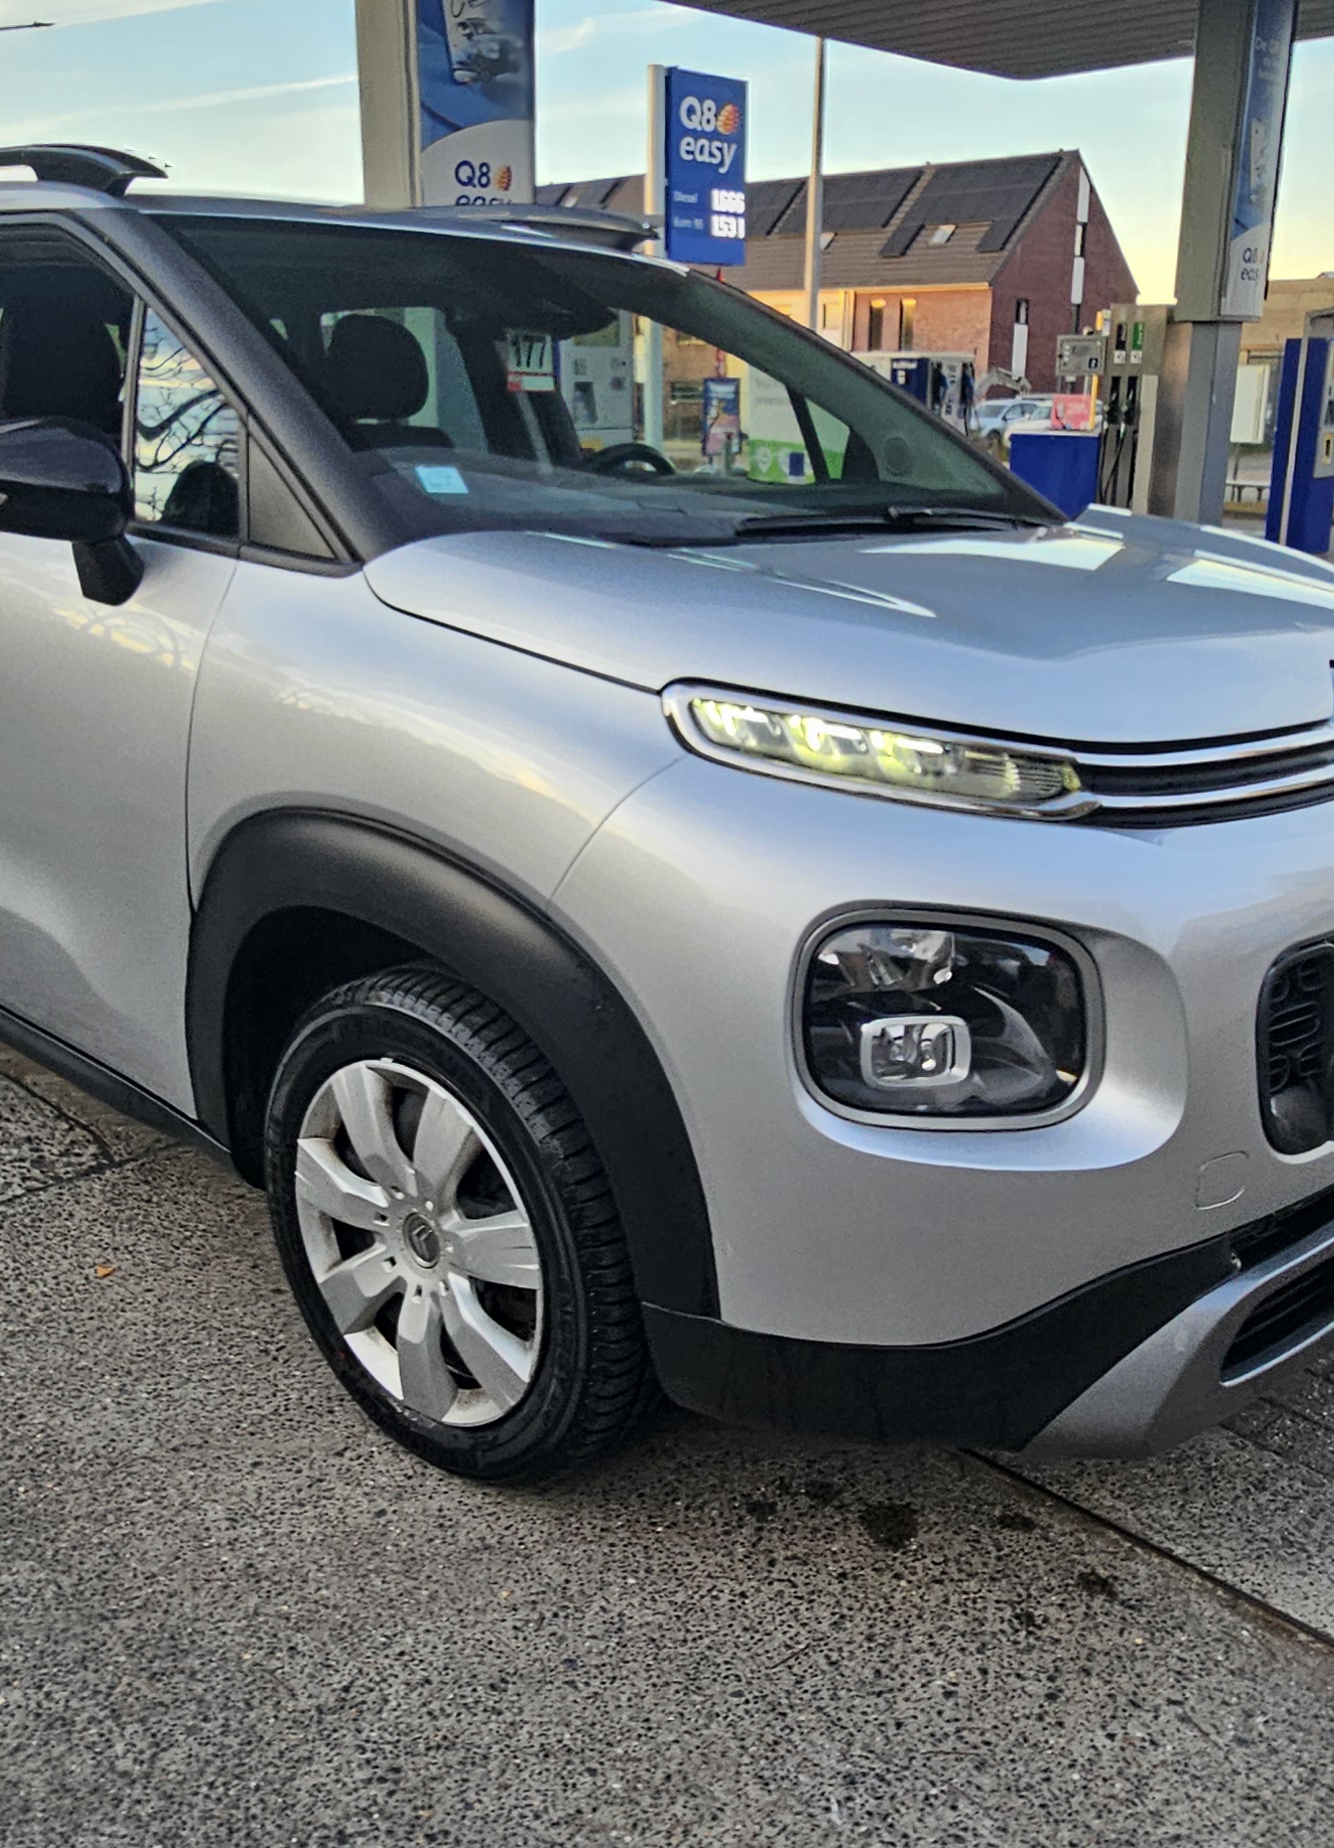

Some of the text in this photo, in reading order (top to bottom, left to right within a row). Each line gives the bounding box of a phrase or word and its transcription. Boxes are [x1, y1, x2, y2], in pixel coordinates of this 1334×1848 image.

[678, 96, 716, 132] Q8
[679, 136, 737, 173] easy
[454, 159, 491, 188] Q8
[510, 334, 546, 369] 177
